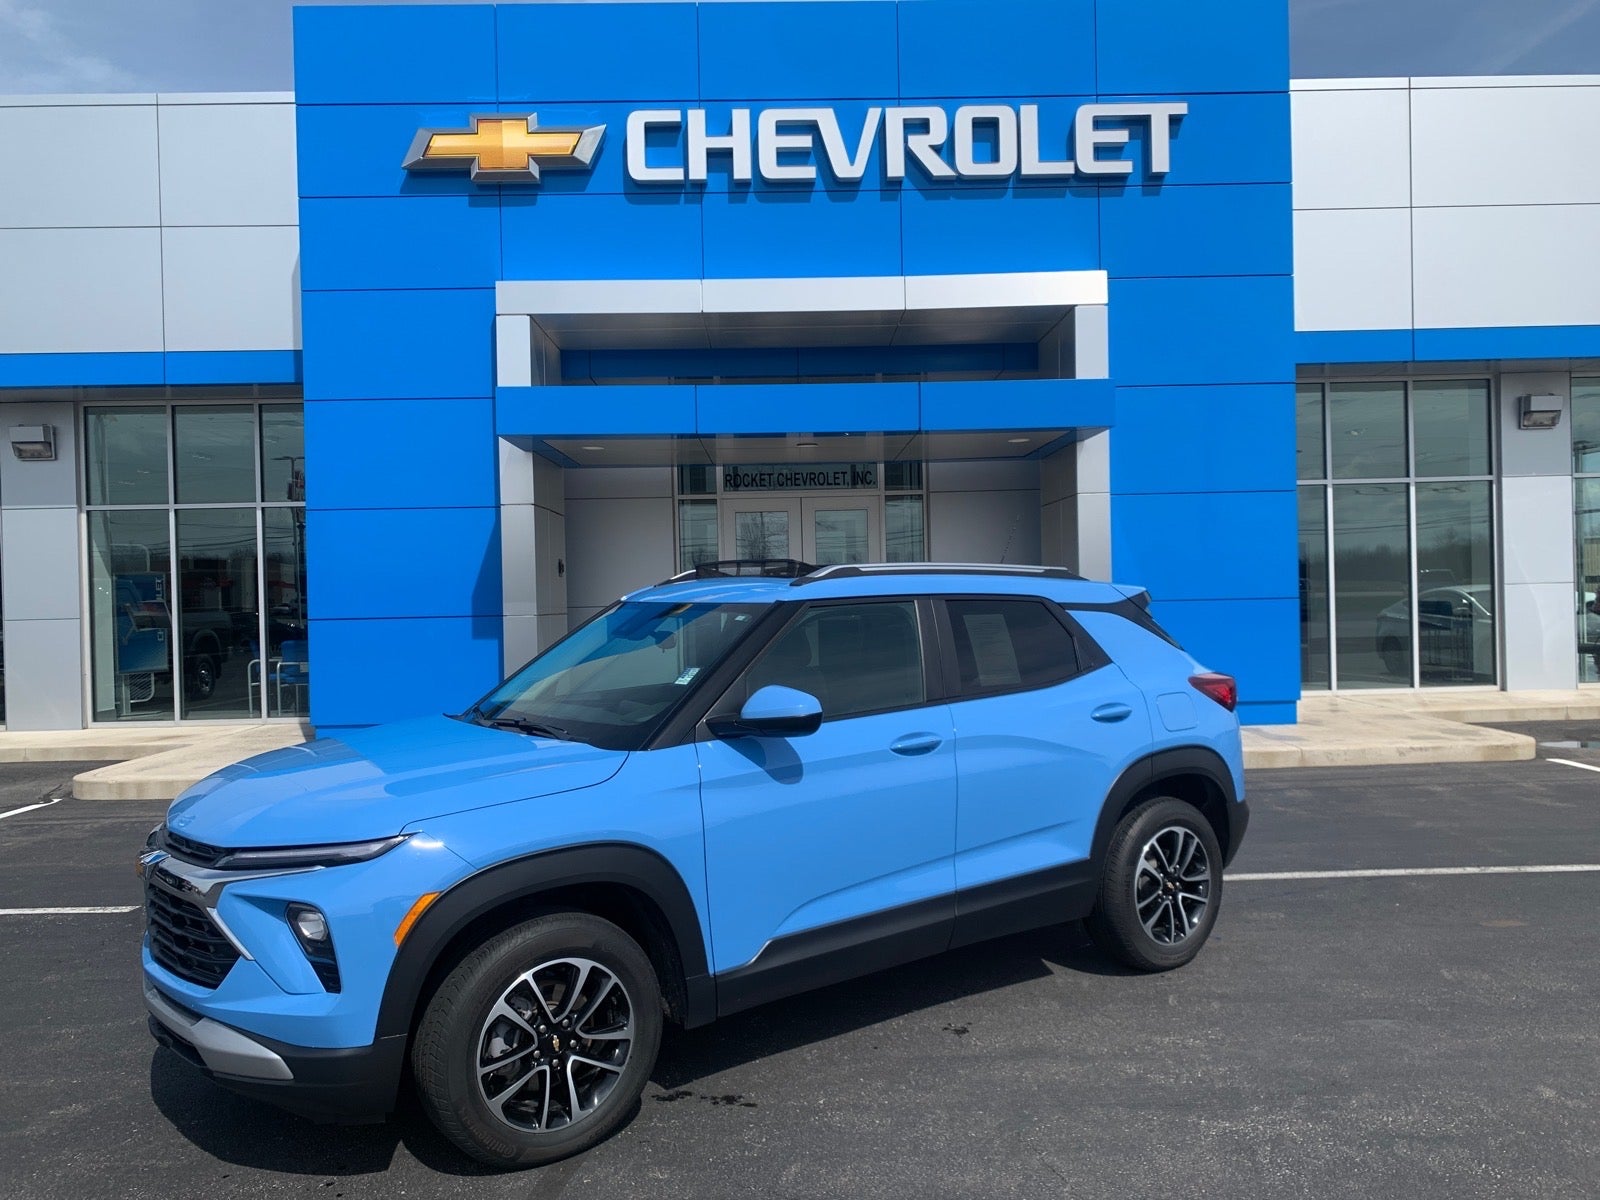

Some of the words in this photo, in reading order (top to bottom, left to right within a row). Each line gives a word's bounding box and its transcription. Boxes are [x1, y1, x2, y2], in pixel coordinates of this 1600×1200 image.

[626, 102, 1188, 182] CHEVROLET
[725, 472, 773, 488] ROCKET
[776, 471, 850, 487] CHEVROLET,
[853, 470, 876, 486] INC.
